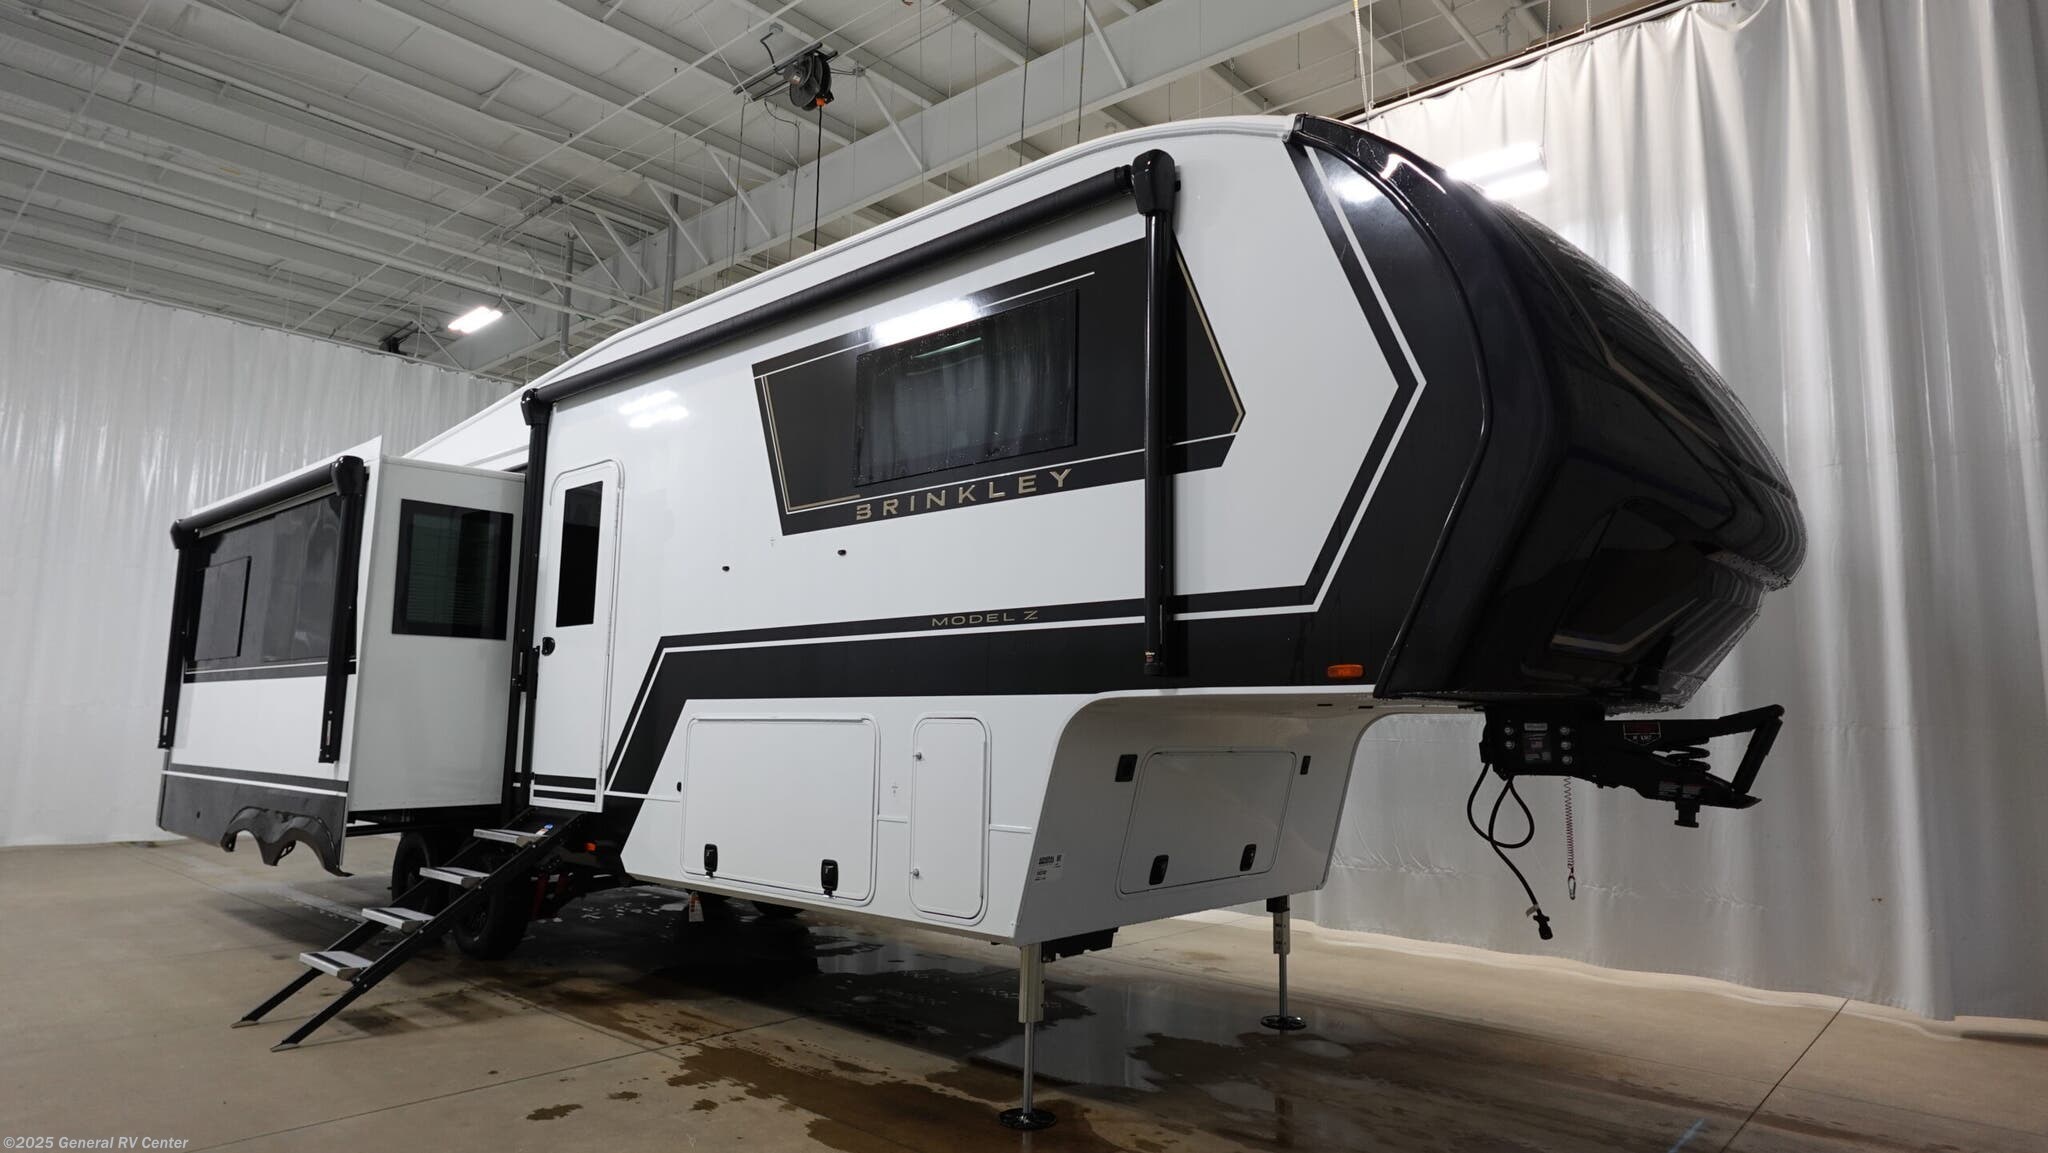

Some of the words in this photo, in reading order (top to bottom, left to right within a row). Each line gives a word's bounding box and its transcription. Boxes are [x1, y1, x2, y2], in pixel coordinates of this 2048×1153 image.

[856, 468, 1072, 521] BRINKLEY
[931, 612, 1015, 627] MODEL
[1023, 610, 1038, 620] Z
